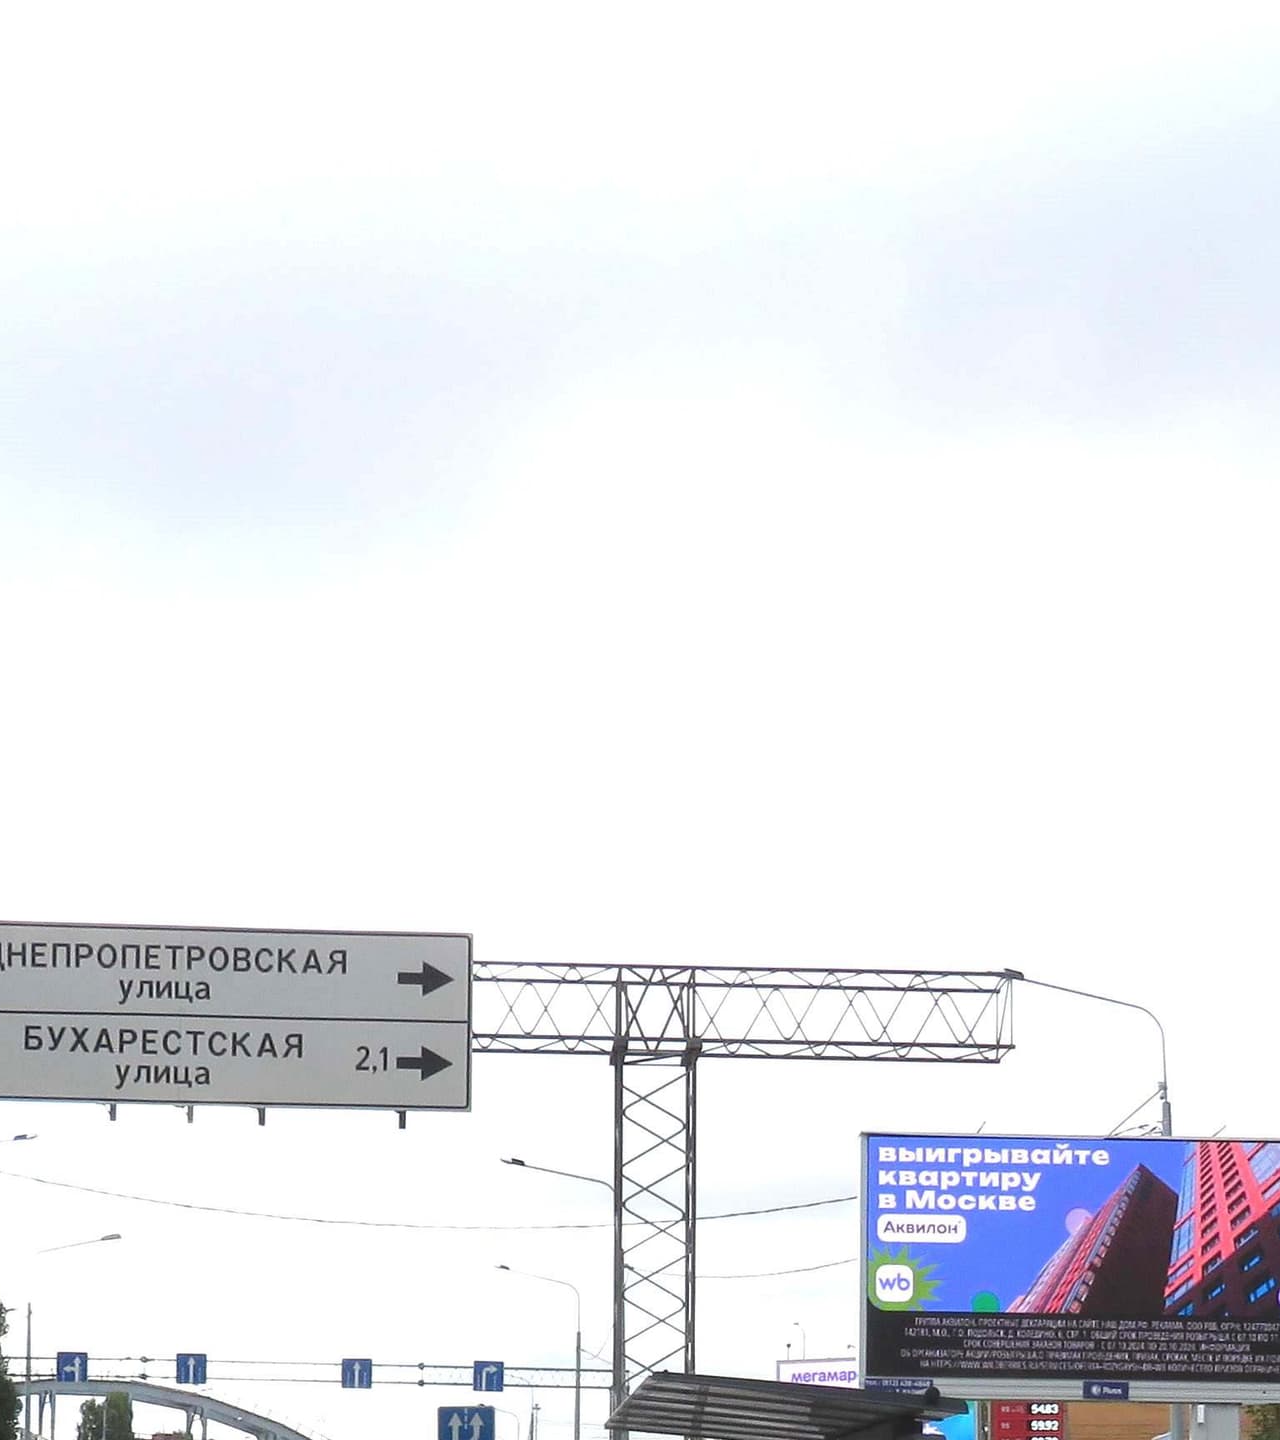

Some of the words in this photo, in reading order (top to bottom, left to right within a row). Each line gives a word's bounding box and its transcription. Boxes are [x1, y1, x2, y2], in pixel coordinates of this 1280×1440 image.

[118, 978, 212, 1003] улица
[23, 1024, 304, 1059] БУХАРЕСТСКАЯ
[354, 1045, 389, 1075] 2,1
[115, 1062, 211, 1090] улица
[878, 1143, 1110, 1167] выигрывайте
[878, 1169, 1041, 1192] квартиру
[878, 1193, 897, 1209] в
[905, 1190, 1036, 1211] Москве
[883, 1220, 959, 1235] Аквилон
[878, 1273, 911, 1291] wb
[791, 1370, 857, 1383] мегамар
